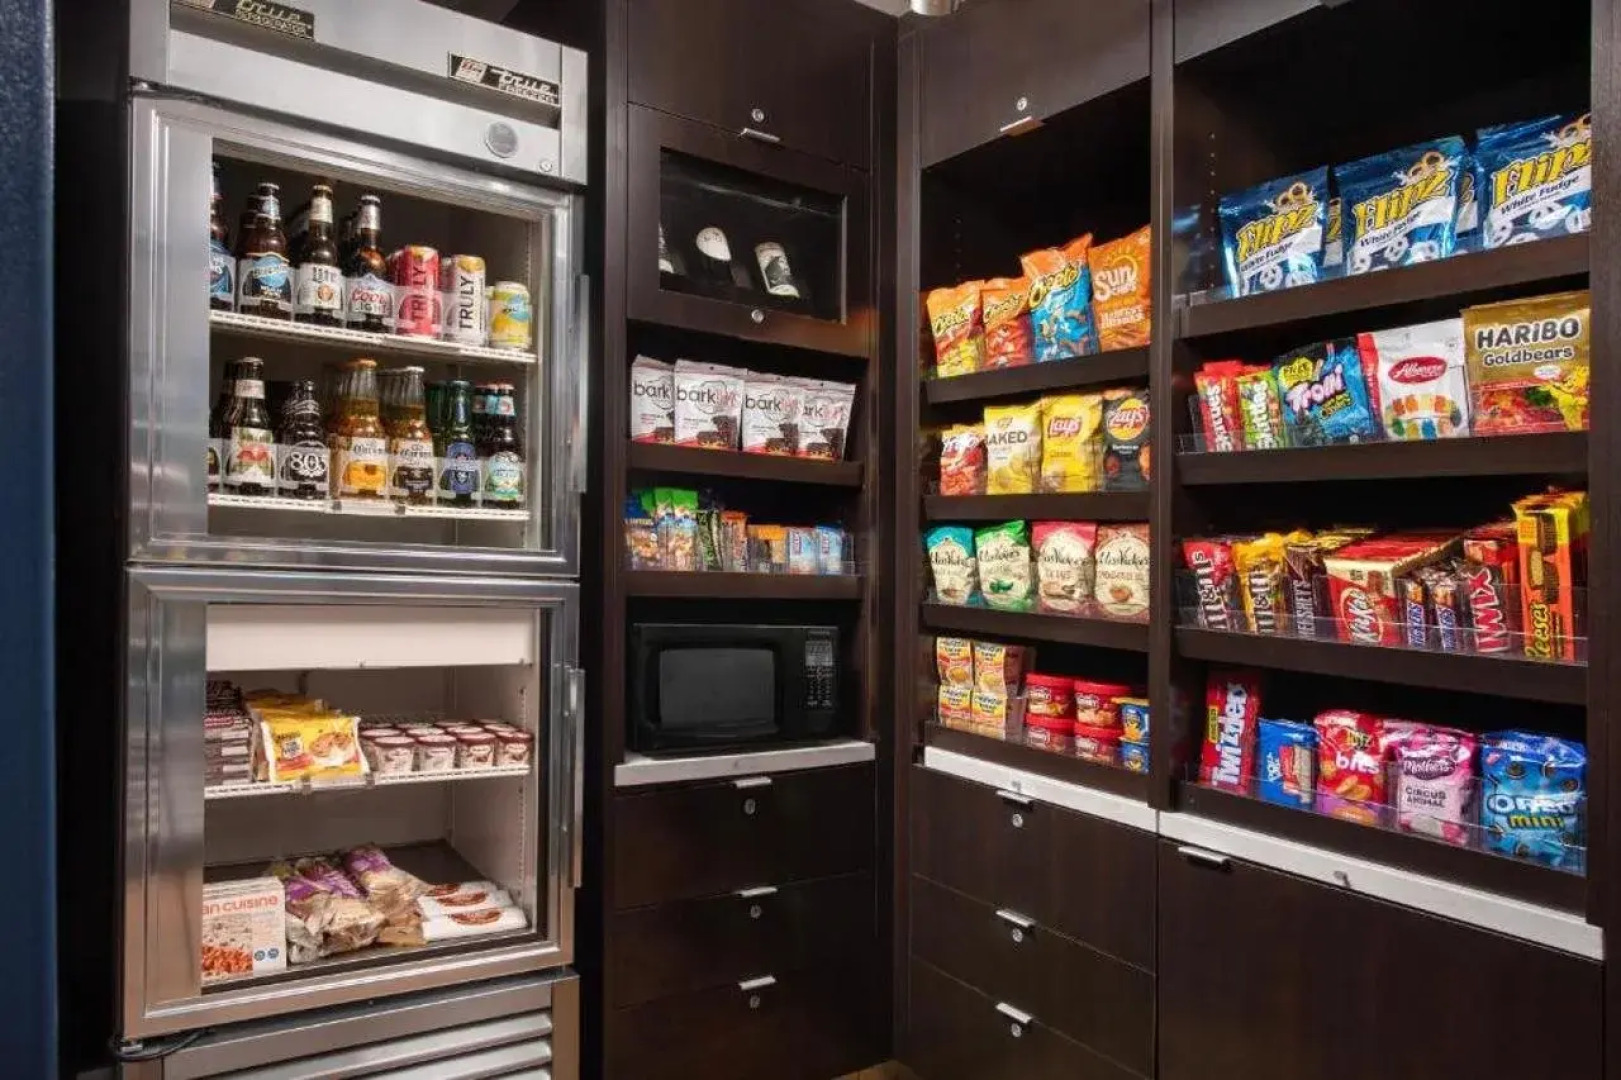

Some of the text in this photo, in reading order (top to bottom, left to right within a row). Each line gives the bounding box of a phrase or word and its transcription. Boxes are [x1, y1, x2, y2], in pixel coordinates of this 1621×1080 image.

[1353, 168, 1450, 239] Flipz
[1236, 202, 1318, 261] Flipz
[1093, 264, 1137, 302] Sun
[459, 275, 475, 329] TRULY
[1476, 316, 1580, 350] HARIBO
[1483, 346, 1574, 367] Goldbears
[1285, 363, 1343, 415] Trolli
[988, 430, 1028, 446] AKED
[1335, 751, 1380, 775] bits
[1405, 786, 1447, 800] CIRCUS
[1508, 814, 1564, 829] mini
